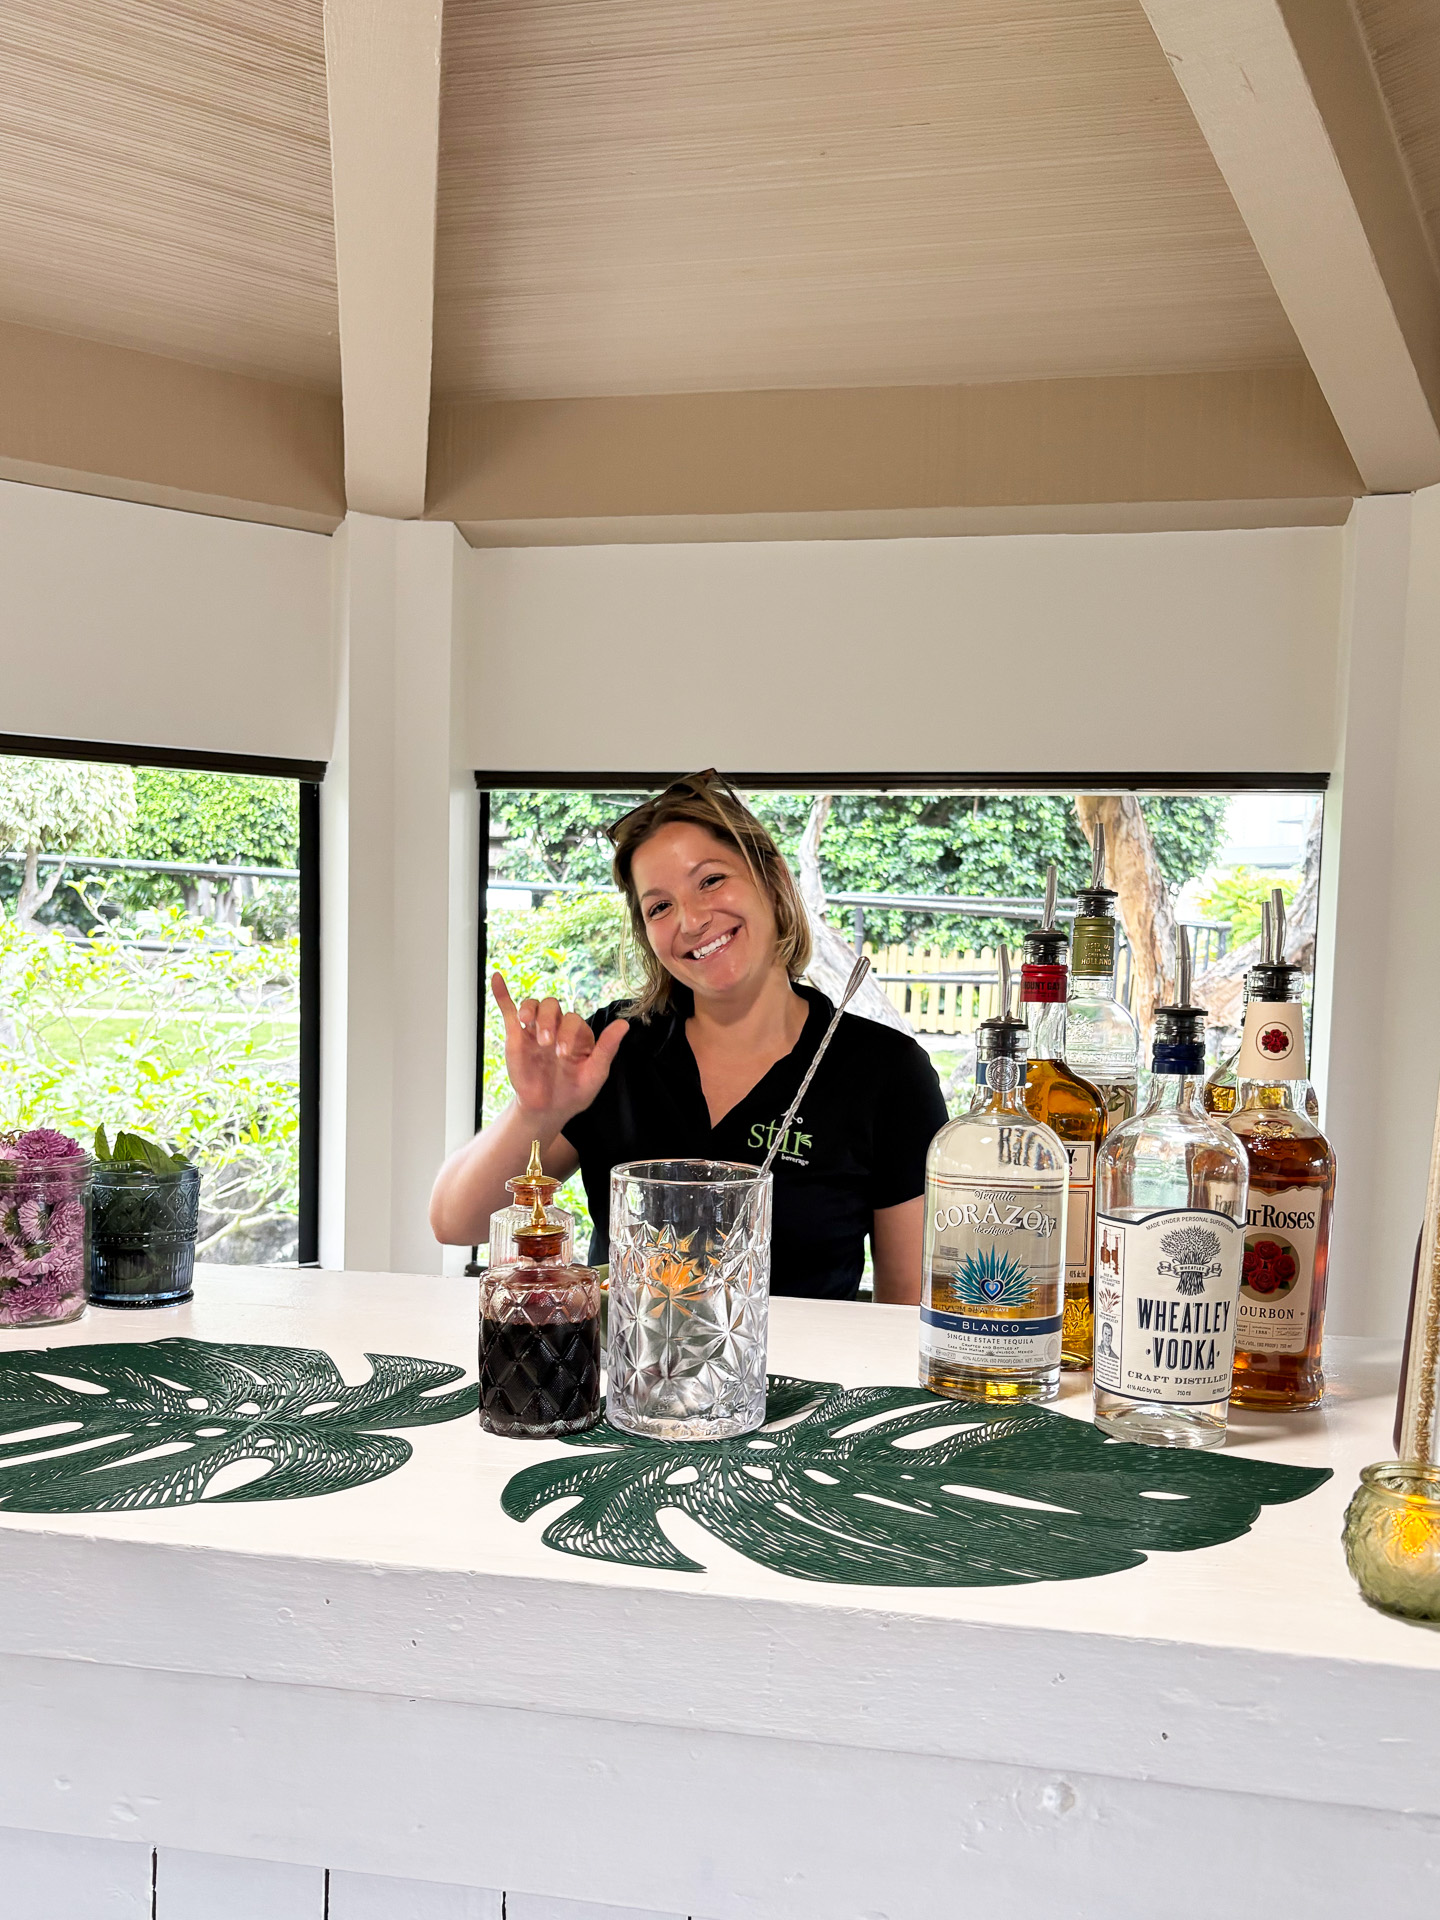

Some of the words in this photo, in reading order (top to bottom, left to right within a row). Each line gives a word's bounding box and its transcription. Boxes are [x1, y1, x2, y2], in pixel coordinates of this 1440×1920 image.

[1081, 957, 1112, 966] HOLLAND
[934, 1203, 1056, 1238] CORAZÓN
[1261, 1204, 1316, 1230] Roses
[1145, 1221, 1160, 1231] MADE
[1161, 1216, 1181, 1226] UNDER
[1209, 1217, 1235, 1234] SUPERVISION
[1136, 1297, 1231, 1335] WHEATLEY
[1240, 1305, 1294, 1319] OURBON
[962, 1321, 1020, 1334] BLANCO
[946, 1332, 971, 1343] SINGLE
[974, 1337, 1001, 1345] ESTATE
[1152, 1336, 1216, 1371] VODKA
[1127, 1370, 1170, 1384] CRAFT
[1174, 1373, 1228, 1385] DISTILLED
[1136, 1384, 1146, 1392] ALC
